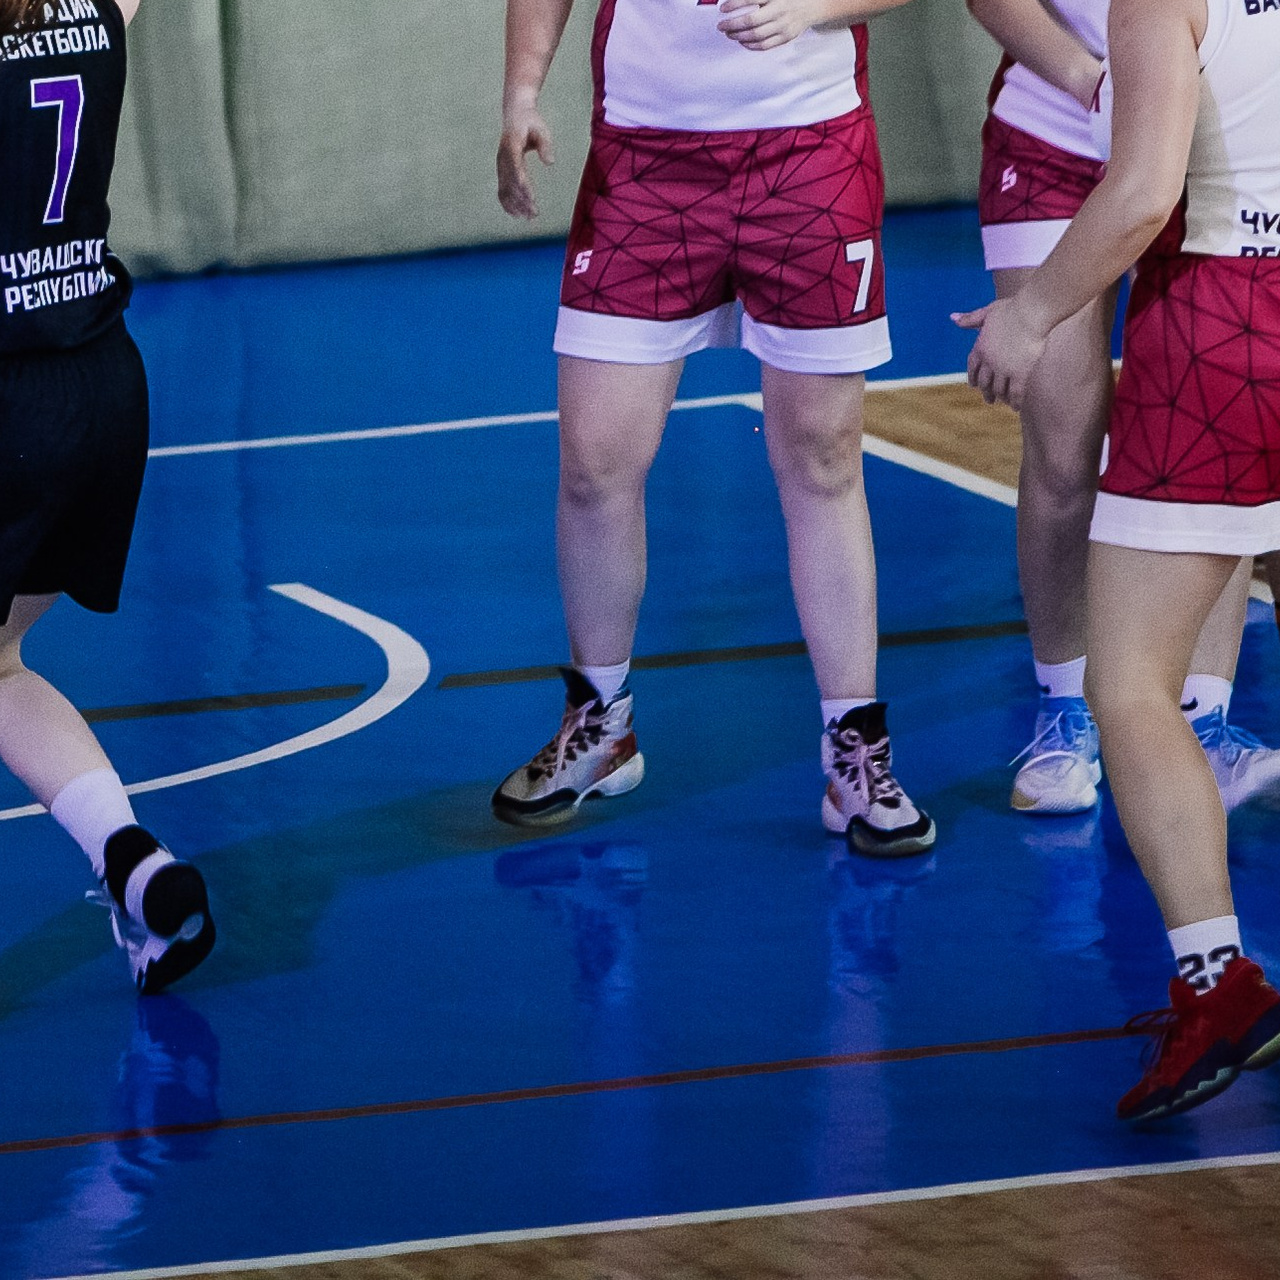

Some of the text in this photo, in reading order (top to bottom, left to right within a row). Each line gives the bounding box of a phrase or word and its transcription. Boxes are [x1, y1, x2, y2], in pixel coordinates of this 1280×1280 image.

[30, 74, 84, 225] 7
[1241, 209, 1280, 235] ЧУ
[845, 238, 874, 315] 7
